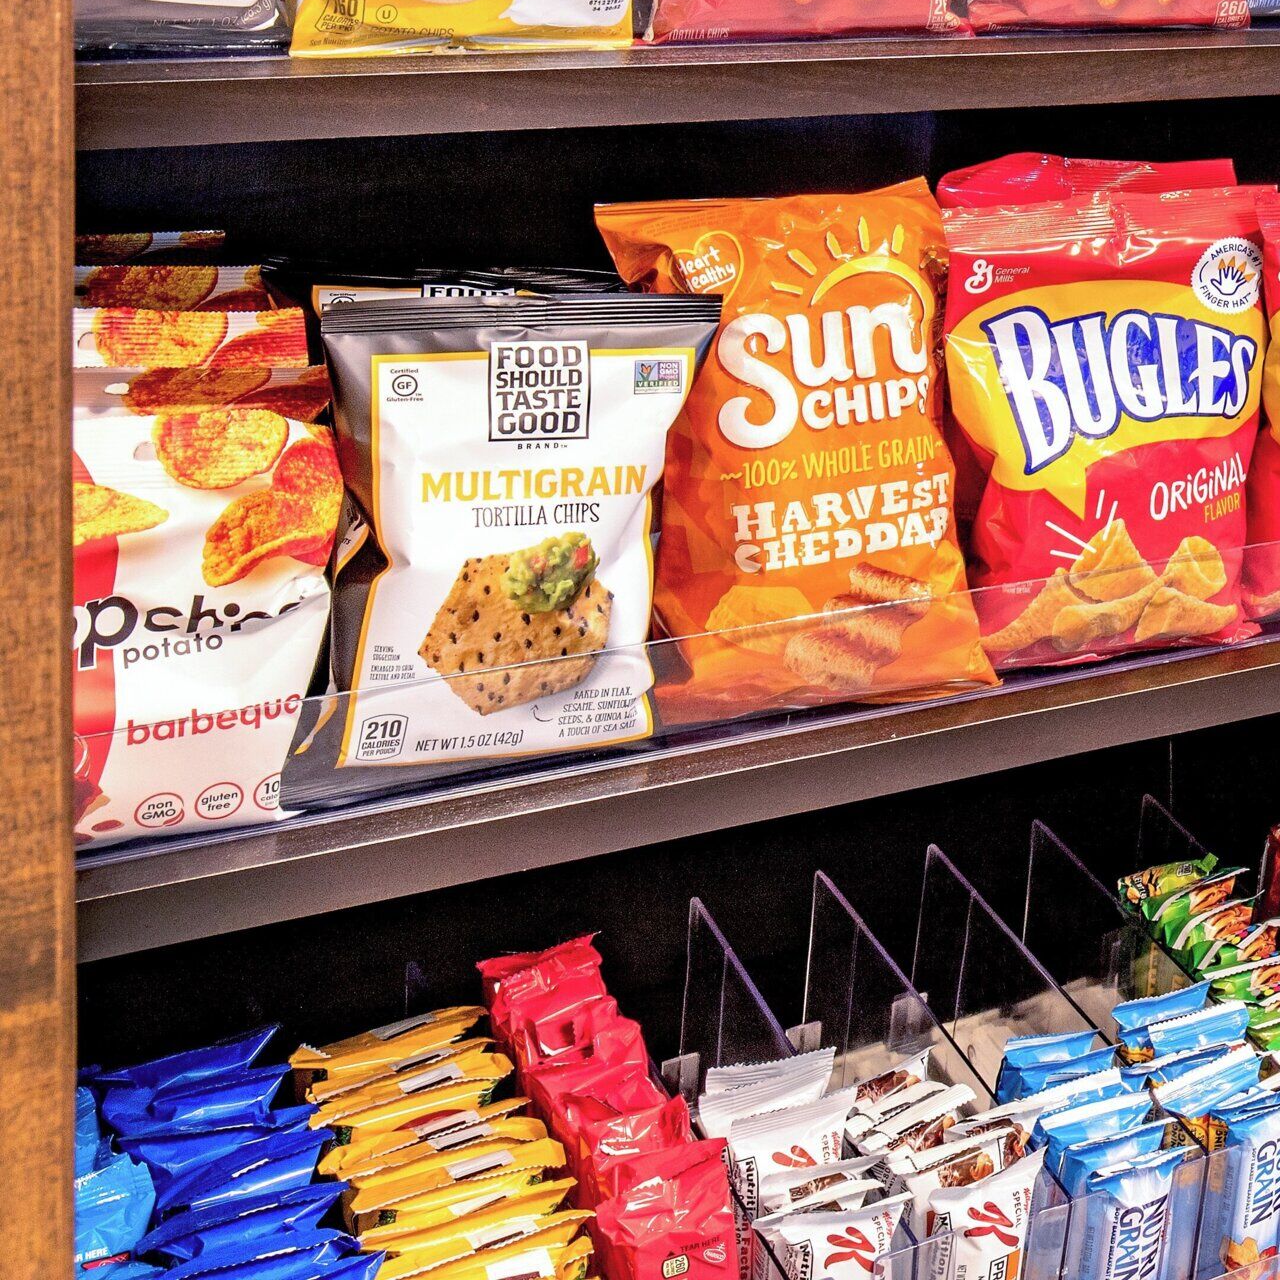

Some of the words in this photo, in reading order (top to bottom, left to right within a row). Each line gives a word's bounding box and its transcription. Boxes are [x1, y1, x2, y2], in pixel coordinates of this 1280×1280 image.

[995, 266, 1030, 275] General
[995, 274, 1014, 284] Mills
[497, 346, 581, 369] FOOD
[496, 369, 582, 388] SHOULD
[717, 302, 930, 450] Sun
[988, 306, 1258, 476] BUGLES
[496, 388, 581, 410] TASTE
[801, 370, 931, 432] CHIPS
[498, 412, 580, 434] GOOD
[742, 455, 799, 489] 100%
[802, 446, 872, 480] WHOLE
[878, 434, 937, 473] GRAIN
[421, 465, 646, 503] MULTIGRAIN
[1149, 460, 1248, 522] ORIGINAL
[473, 505, 548, 528] TORTILLA
[554, 503, 600, 524] CHIPS
[732, 472, 950, 544] HARVEST
[1204, 492, 1242, 524] FLAVOR
[733, 506, 949, 575] CHEDDAR
[123, 633, 223, 669] potato
[127, 694, 301, 746] barbeque
[365, 720, 400, 740] 210
[361, 739, 400, 750] CALORIES
[148, 800, 172, 811] non
[201, 791, 238, 805] gluten
[207, 801, 230, 812] free
[142, 809, 176, 820] GMO
[1250, 1140, 1277, 1227] GRAIN
[1012, 1191, 1022, 1228] SPECIAL
[871, 1215, 884, 1254] SPECIAL
